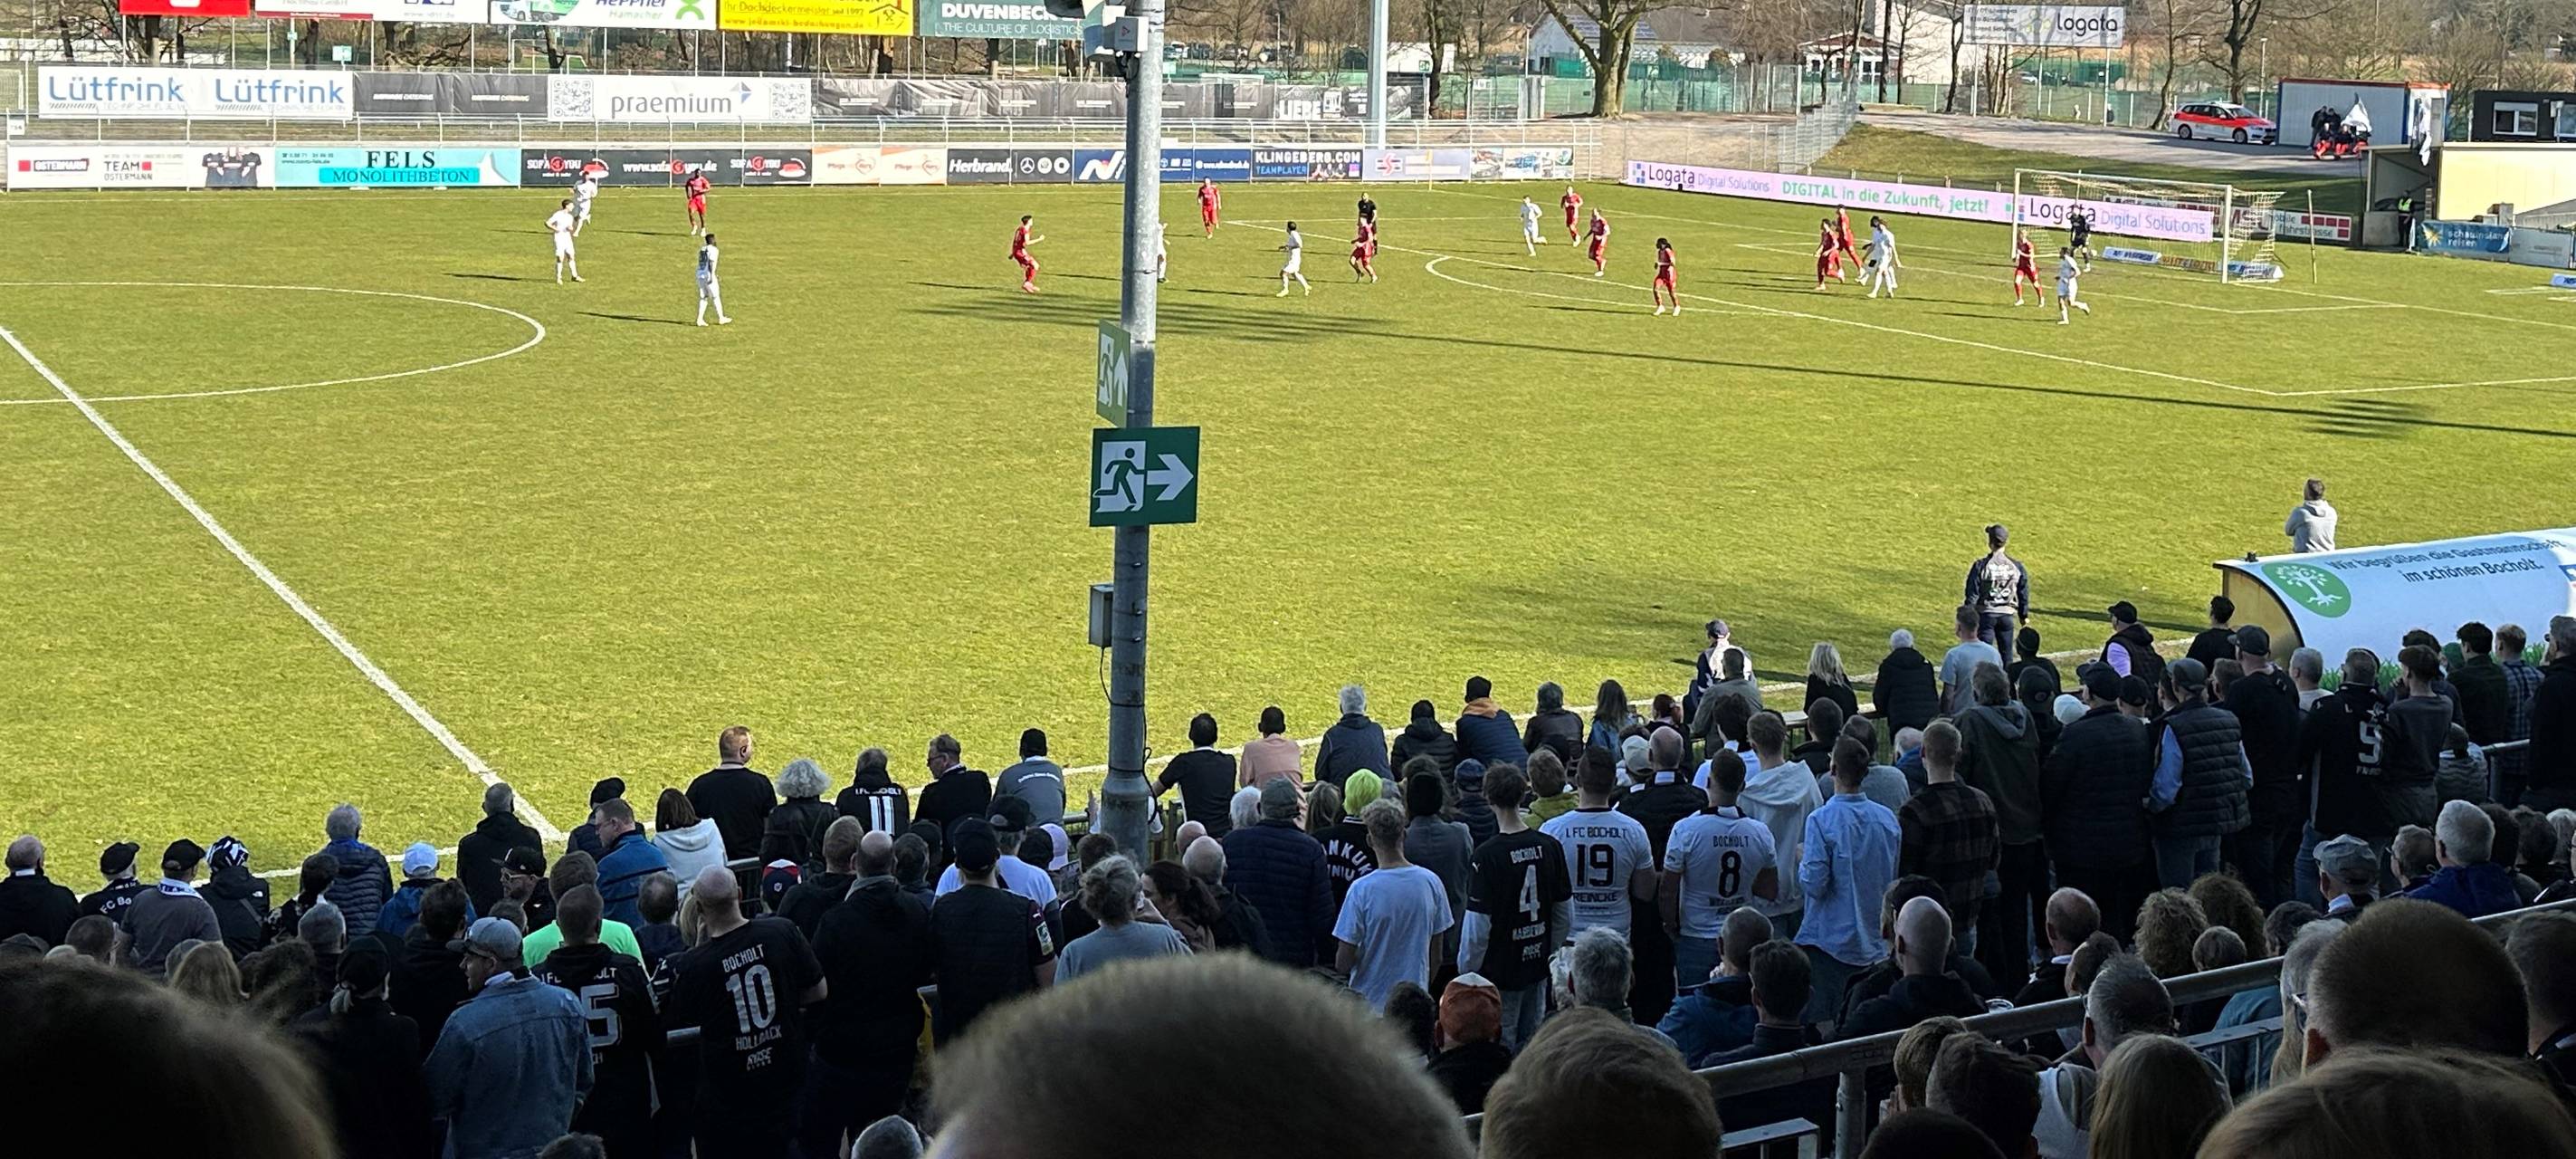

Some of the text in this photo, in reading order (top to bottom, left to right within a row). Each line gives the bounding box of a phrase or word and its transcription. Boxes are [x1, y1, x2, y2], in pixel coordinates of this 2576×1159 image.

[943, 22, 1083, 34] THE CULTURE OF LOGISTICS
[2057, 13, 2117, 36] logata
[49, 75, 183, 101] Lütfrink
[215, 78, 344, 103] Lütfrink
[612, 93, 731, 118] praemium
[104, 161, 139, 171] TEAM
[367, 151, 435, 168] FELS
[333, 169, 469, 183] MONOLITHBETON
[1648, 164, 1695, 187] Logata
[1728, 177, 1770, 194] Solutions
[1782, 180, 1837, 200] DIGITAL
[1841, 189, 1855, 201] in
[1859, 189, 1881, 204] die
[1884, 189, 1944, 211] Zukunft,
[1949, 196, 1989, 214] jetzt!
[2101, 209, 2141, 232] Digital
[2145, 214, 2205, 235] Solutions
[2325, 559, 2355, 570] Wir
[2428, 549, 2452, 560] die
[2399, 558, 2544, 583] im schönen Bocholt.
[1572, 827, 1586, 838] FC
[1587, 827, 1628, 839] BOCHOLT
[1713, 835, 1750, 848] BOCHOLT
[1576, 844, 1614, 887] 19
[1718, 849, 1741, 898] 8
[1519, 864, 1541, 922] 4
[722, 943, 765, 973] BOCHOLT
[725, 963, 776, 1034] 10
[580, 982, 623, 1049] 5
